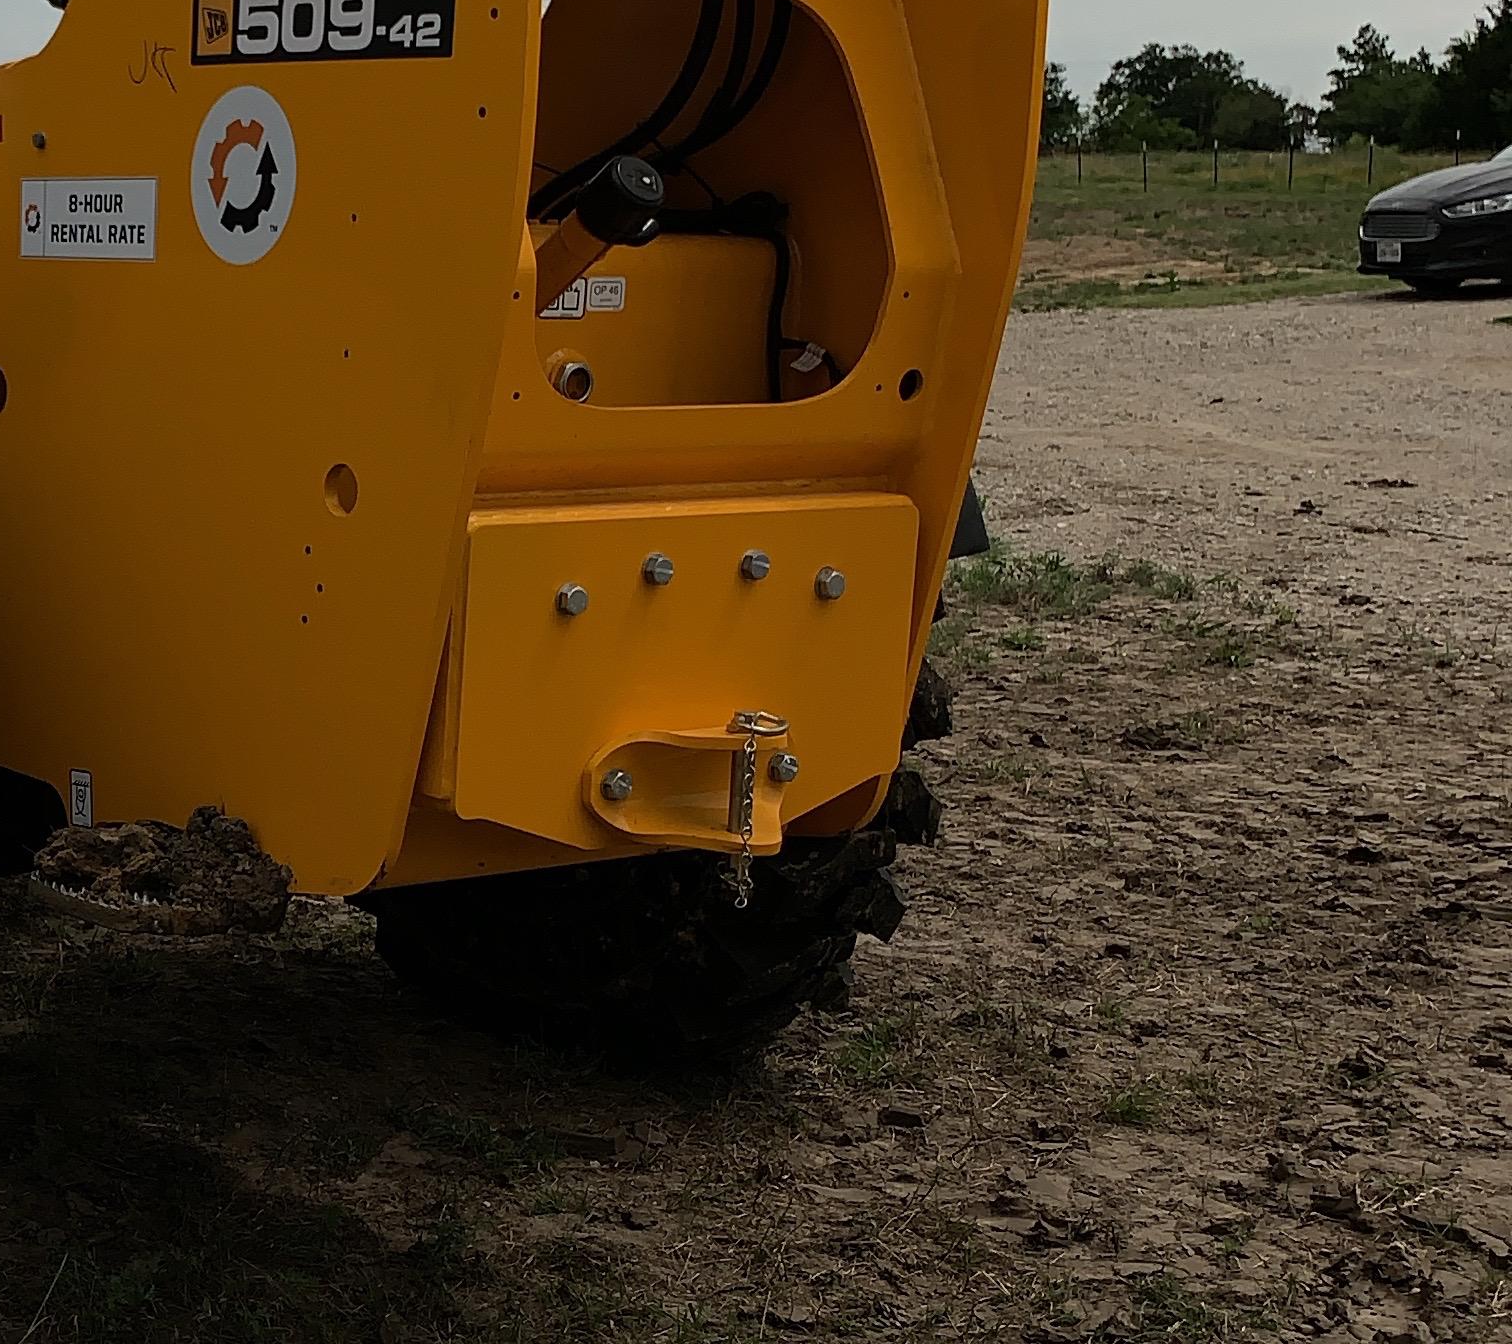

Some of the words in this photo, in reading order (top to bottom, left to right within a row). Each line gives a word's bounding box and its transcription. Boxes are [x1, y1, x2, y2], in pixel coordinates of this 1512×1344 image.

[205, 10, 227, 41] JCB
[67, 194, 124, 214] 8-HOUR
[50, 223, 104, 245] RENTAL
[107, 224, 146, 245] RATE
[593, 285, 608, 296] OP
